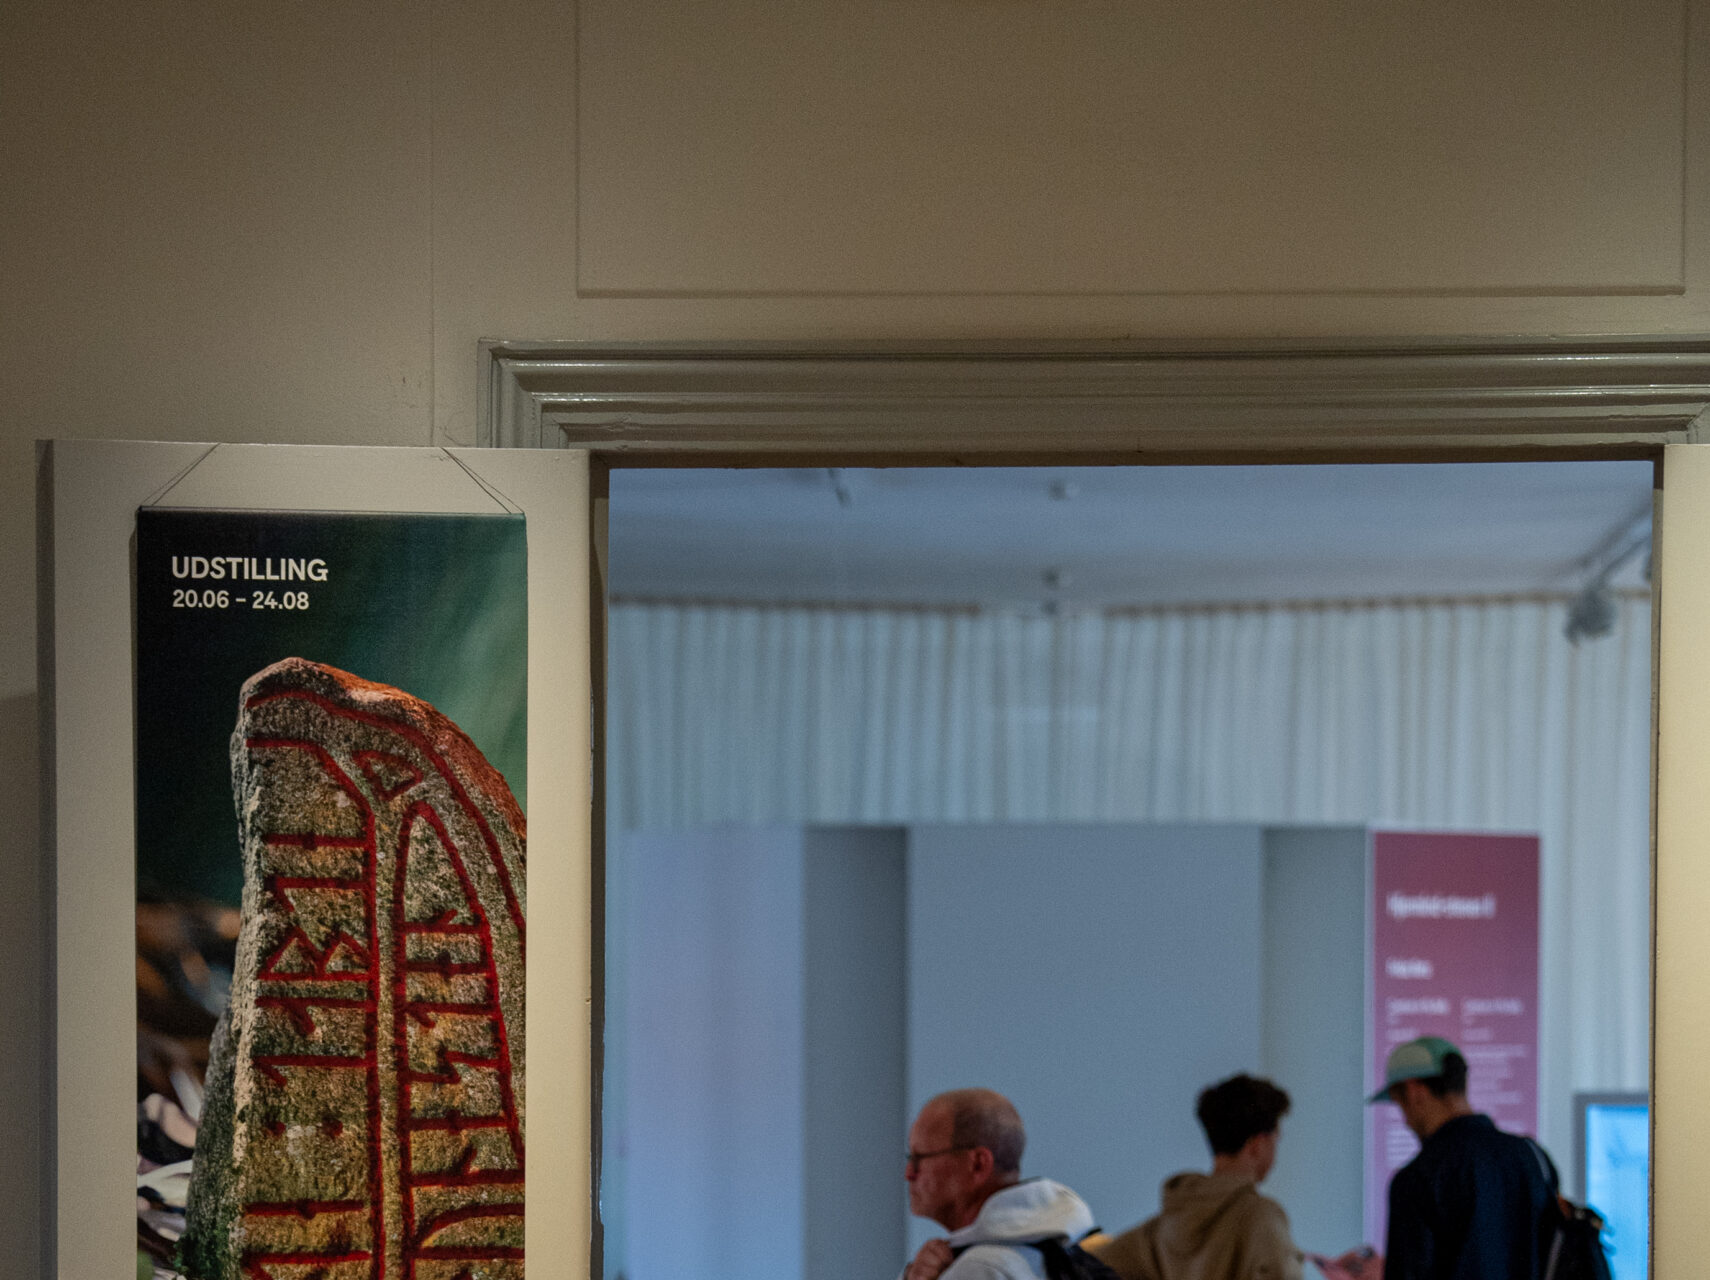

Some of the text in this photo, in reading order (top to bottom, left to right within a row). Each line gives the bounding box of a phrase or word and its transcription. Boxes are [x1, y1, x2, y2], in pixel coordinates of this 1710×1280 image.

[172, 556, 328, 581] UDSTILLING
[173, 589, 229, 608] 20.06
[252, 591, 309, 610] 24.08
